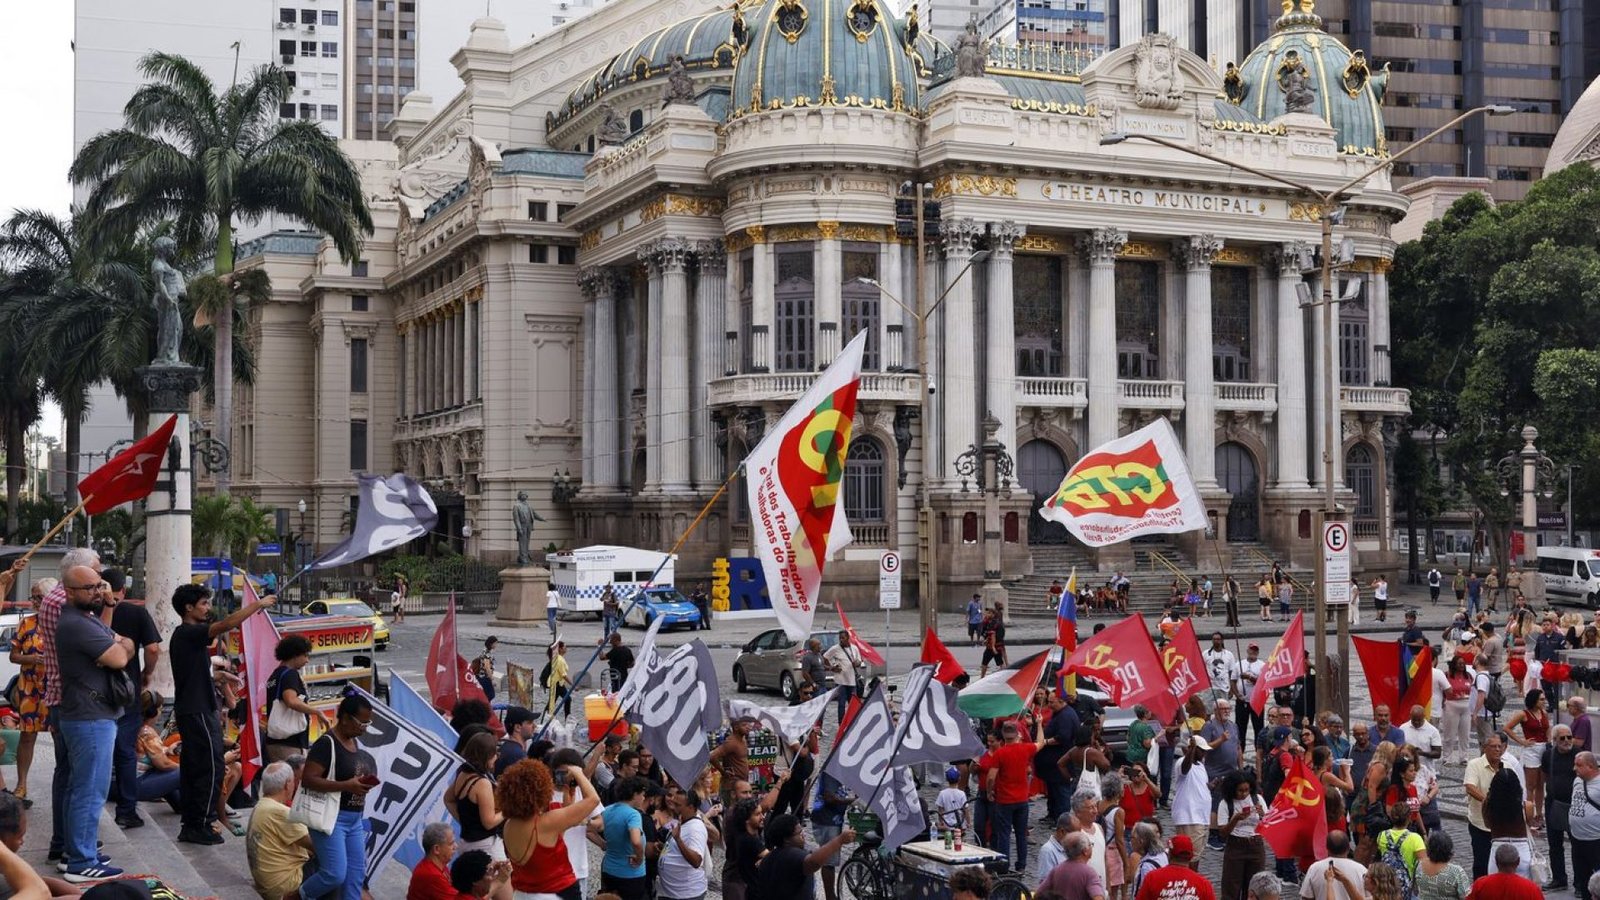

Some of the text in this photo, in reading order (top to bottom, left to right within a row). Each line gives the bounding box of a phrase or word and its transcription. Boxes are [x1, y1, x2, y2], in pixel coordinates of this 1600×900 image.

[1057, 184, 1254, 214] THEATRO MUNICIPAL
[1332, 529, 1341, 545] E
[775, 511, 811, 612] Trabalhadores
[887, 556, 894, 568] E
[772, 546, 785, 563] do
[780, 568, 799, 609] Brasil
